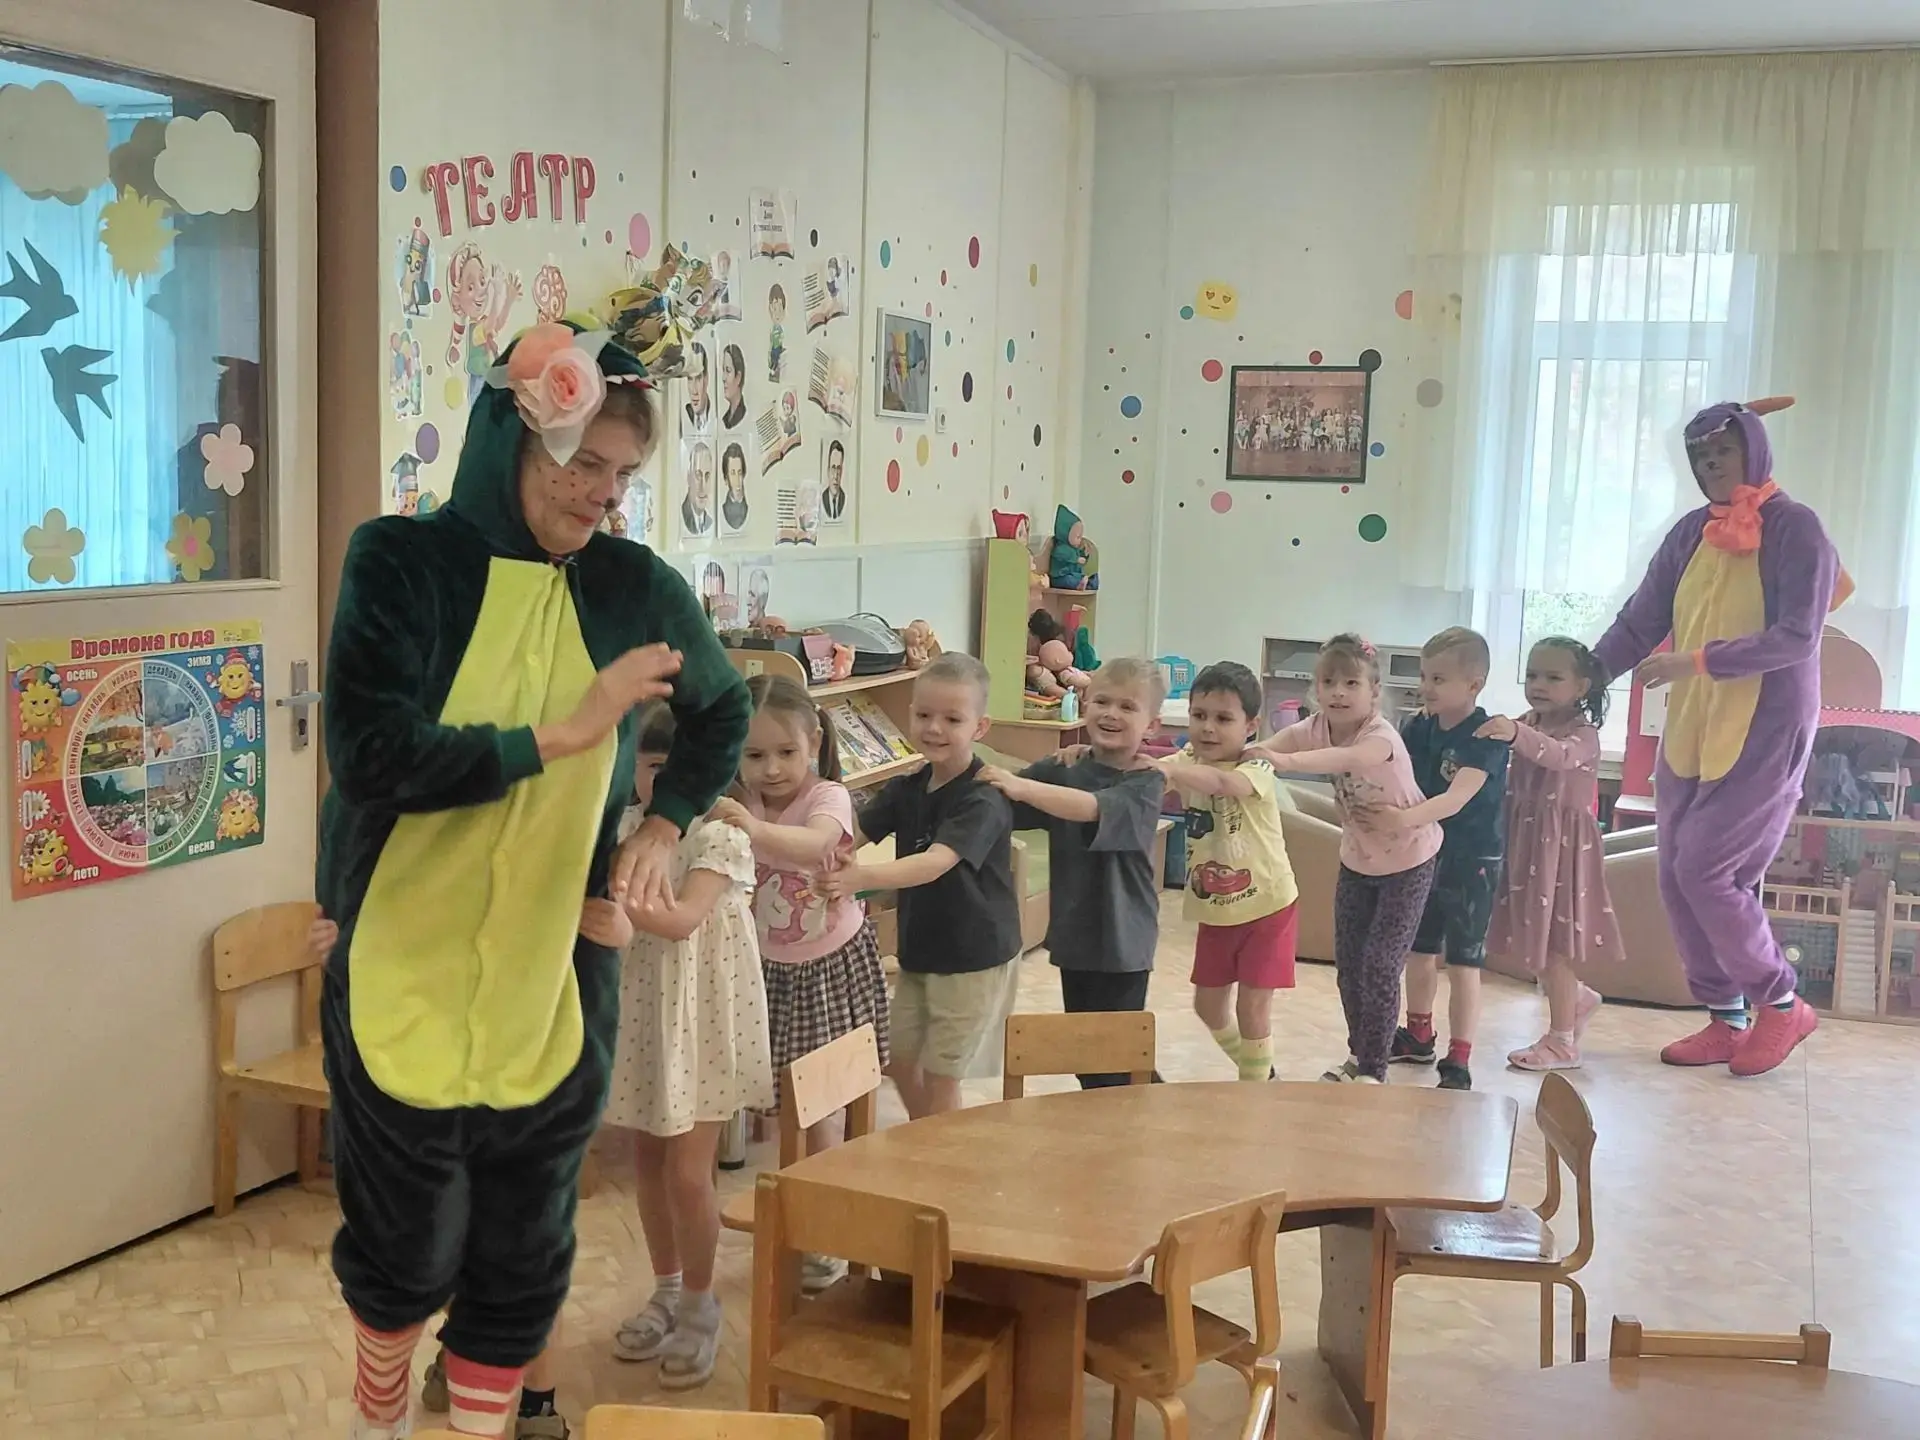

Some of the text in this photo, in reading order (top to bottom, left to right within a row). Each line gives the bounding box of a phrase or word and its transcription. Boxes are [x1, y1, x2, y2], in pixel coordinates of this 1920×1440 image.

[424, 151, 596, 238] ТЕАТР
[169, 629, 215, 650] года
[187, 655, 212, 668] зима
[66, 668, 98, 682] осень
[147, 665, 177, 680] декабрь
[69, 730, 83, 775] сентябрь
[188, 840, 216, 856] весна
[72, 865, 99, 881] лето
